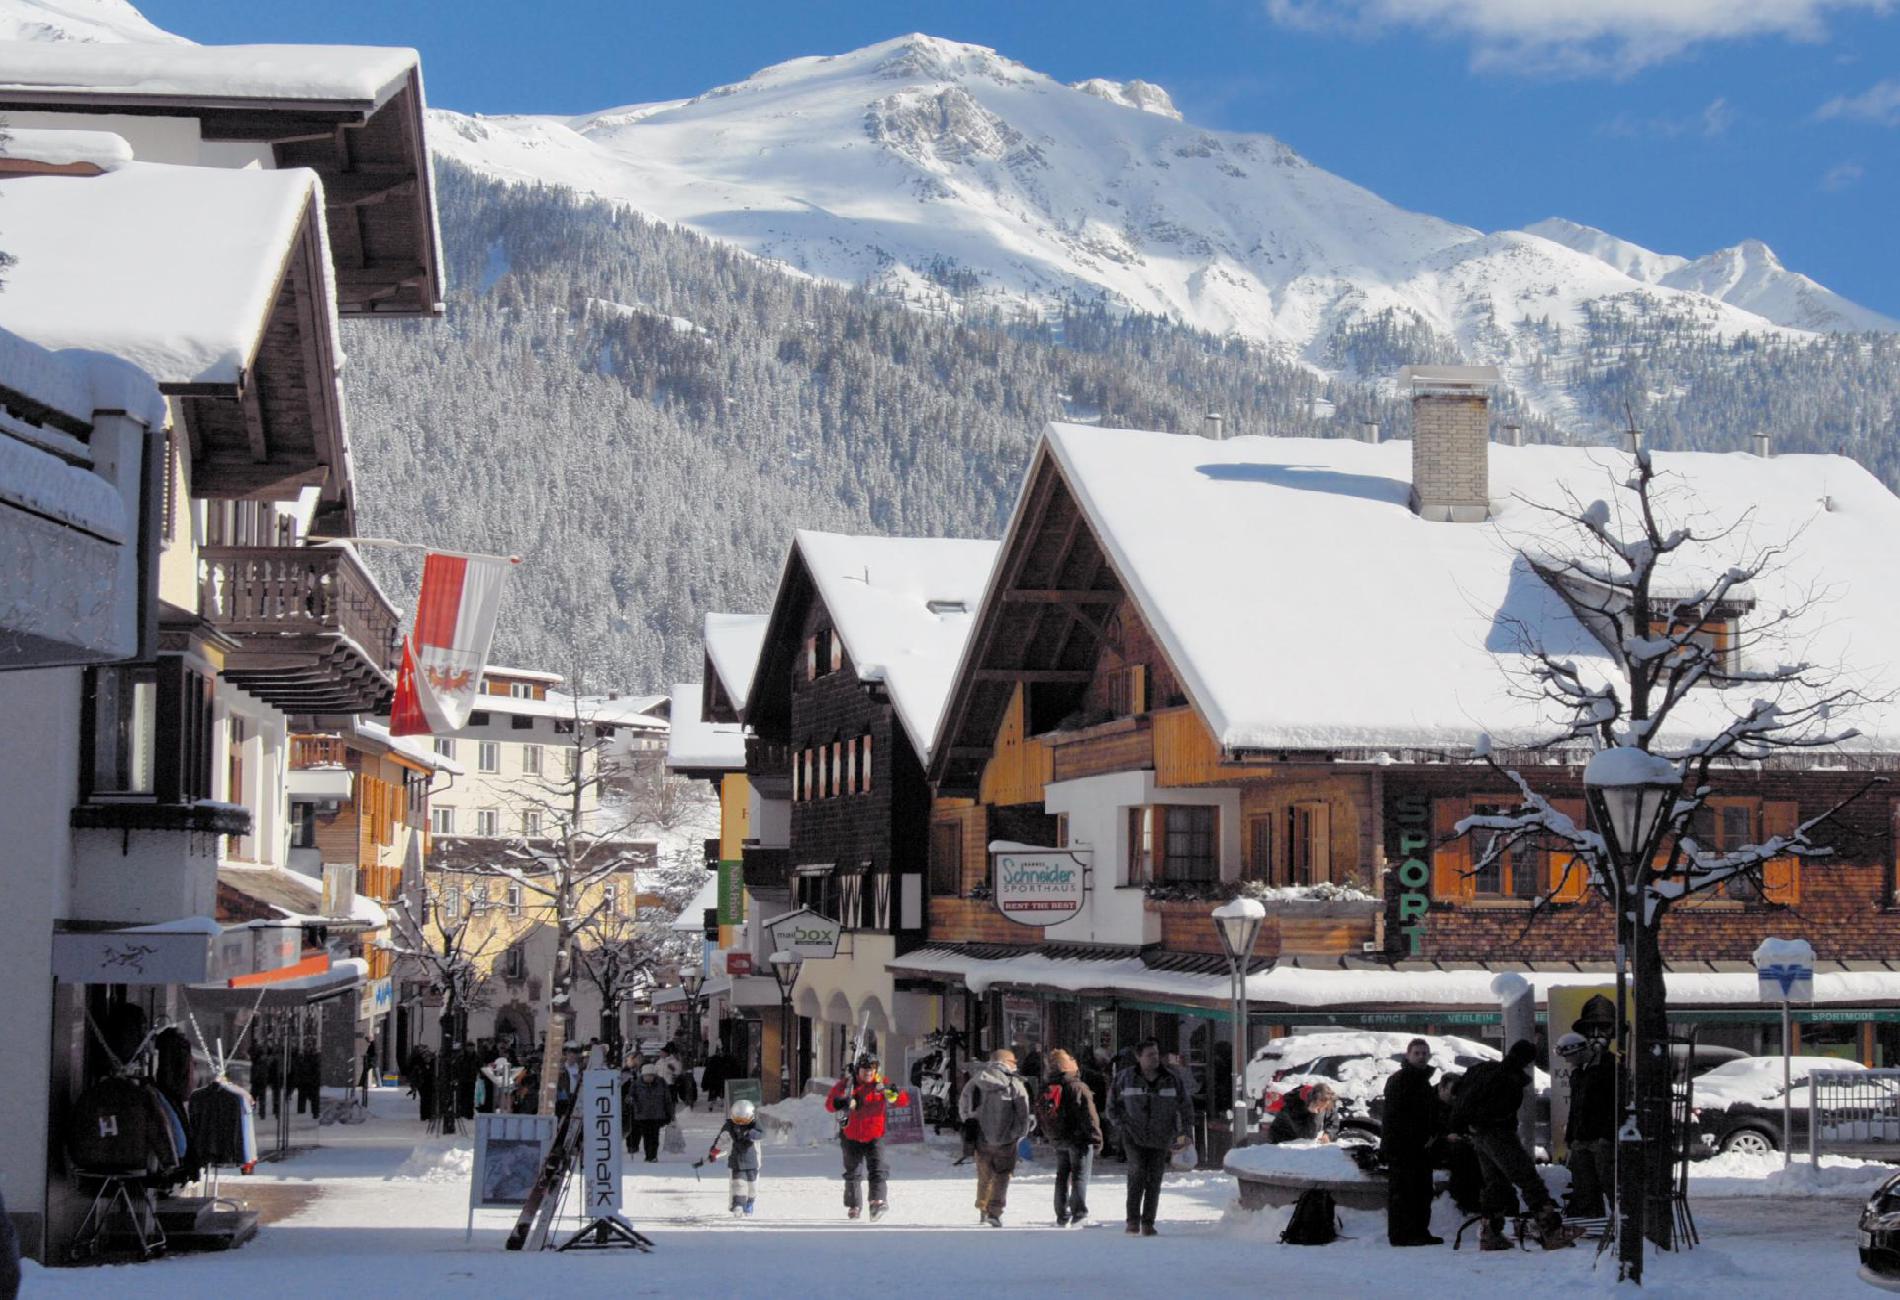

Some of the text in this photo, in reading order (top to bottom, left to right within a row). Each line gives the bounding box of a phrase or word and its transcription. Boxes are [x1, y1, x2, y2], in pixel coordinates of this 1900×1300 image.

[1002, 857, 1076, 884] Schneider
[1398, 795, 1430, 956] SPORT
[1003, 884, 1076, 893] SPORTHAUS
[1005, 902, 1075, 910] RENT THE BEST
[1360, 1014, 1494, 1025] SERVICE VERLEIH
[1811, 1012, 1875, 1021] SPORTMODE
[595, 1079, 615, 1207] Telemark
